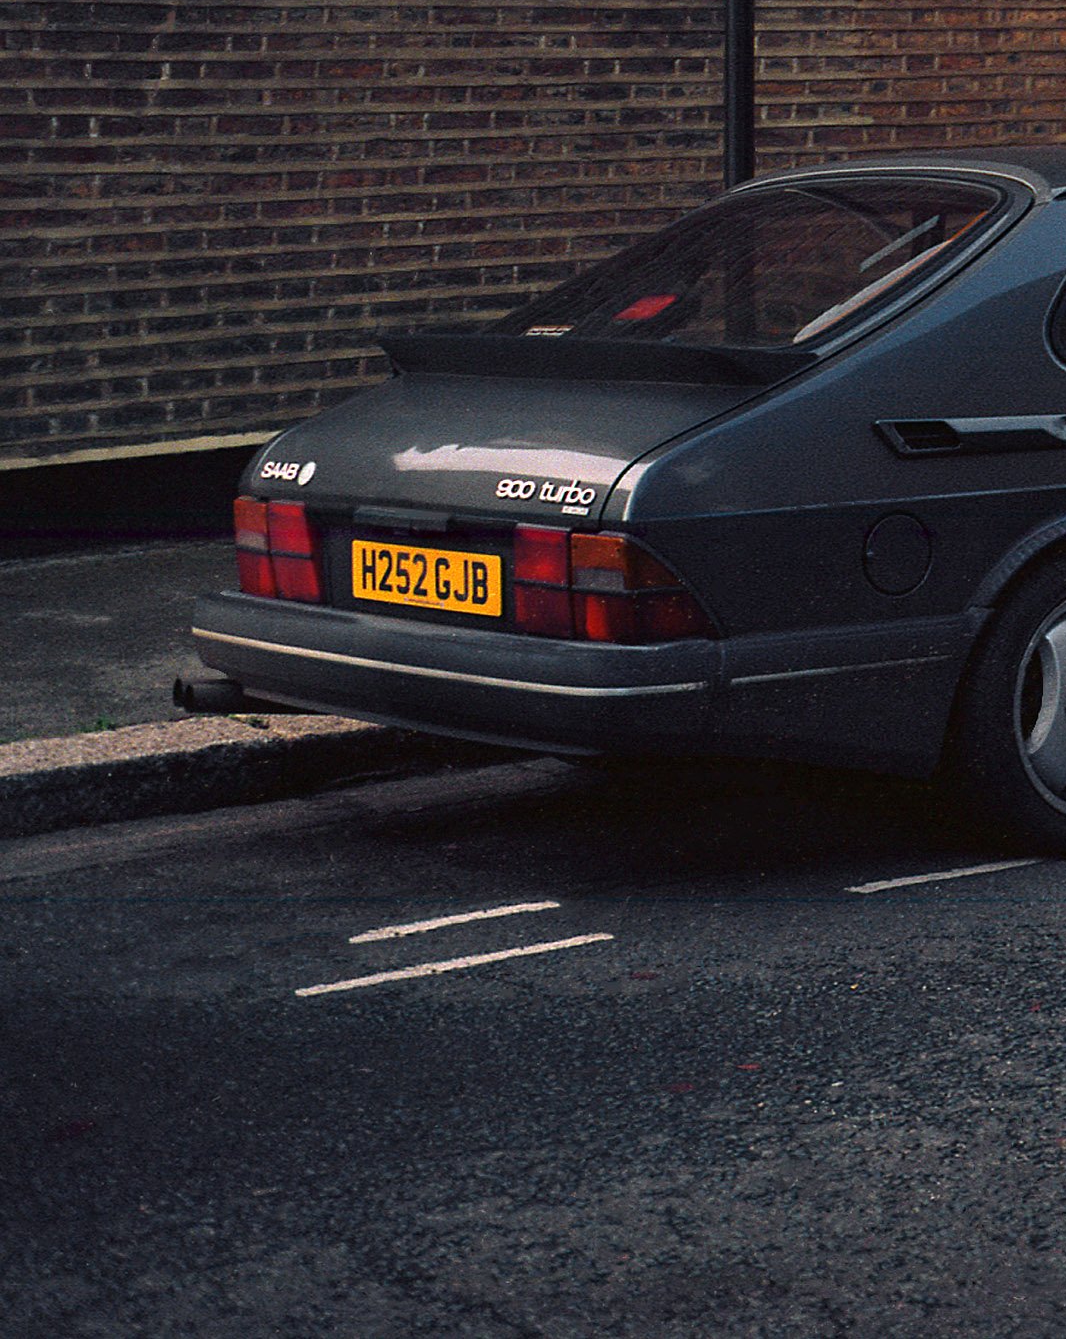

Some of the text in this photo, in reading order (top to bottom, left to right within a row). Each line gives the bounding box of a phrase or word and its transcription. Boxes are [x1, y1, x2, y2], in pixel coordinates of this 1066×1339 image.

[260, 461, 300, 480] SAAB
[495, 478, 596, 505] 900 turbo
[362, 548, 489, 606] H252 GJB
